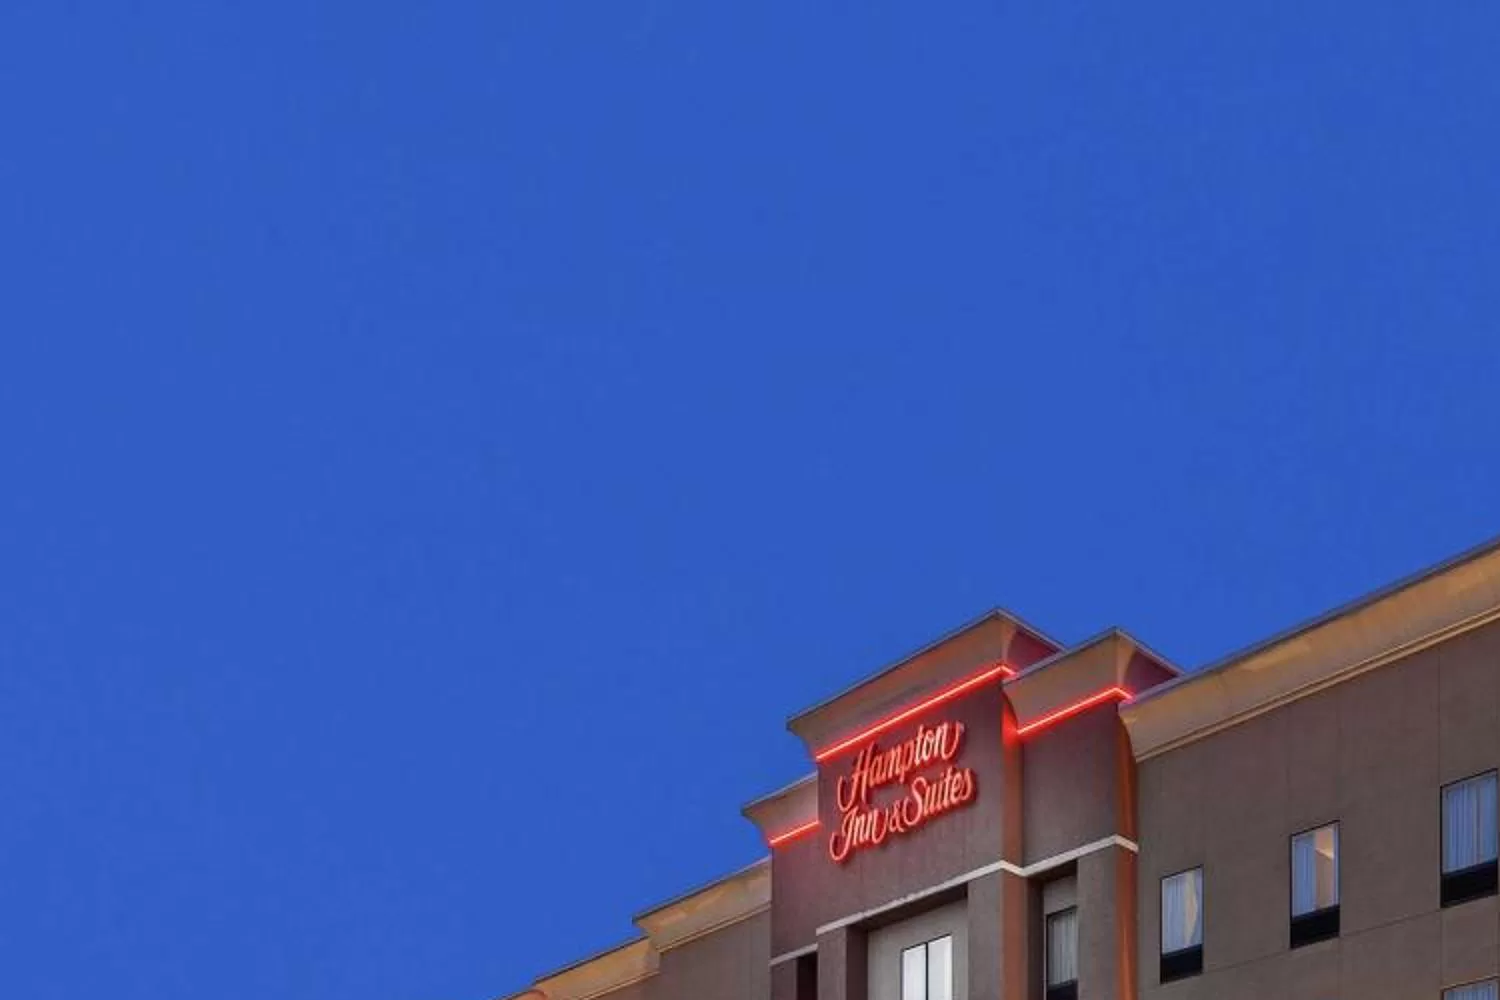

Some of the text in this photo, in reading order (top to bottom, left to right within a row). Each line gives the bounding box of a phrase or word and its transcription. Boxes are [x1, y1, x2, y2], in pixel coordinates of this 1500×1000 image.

[837, 720, 964, 812] Hampton
[829, 767, 974, 862] Inn & Suites
